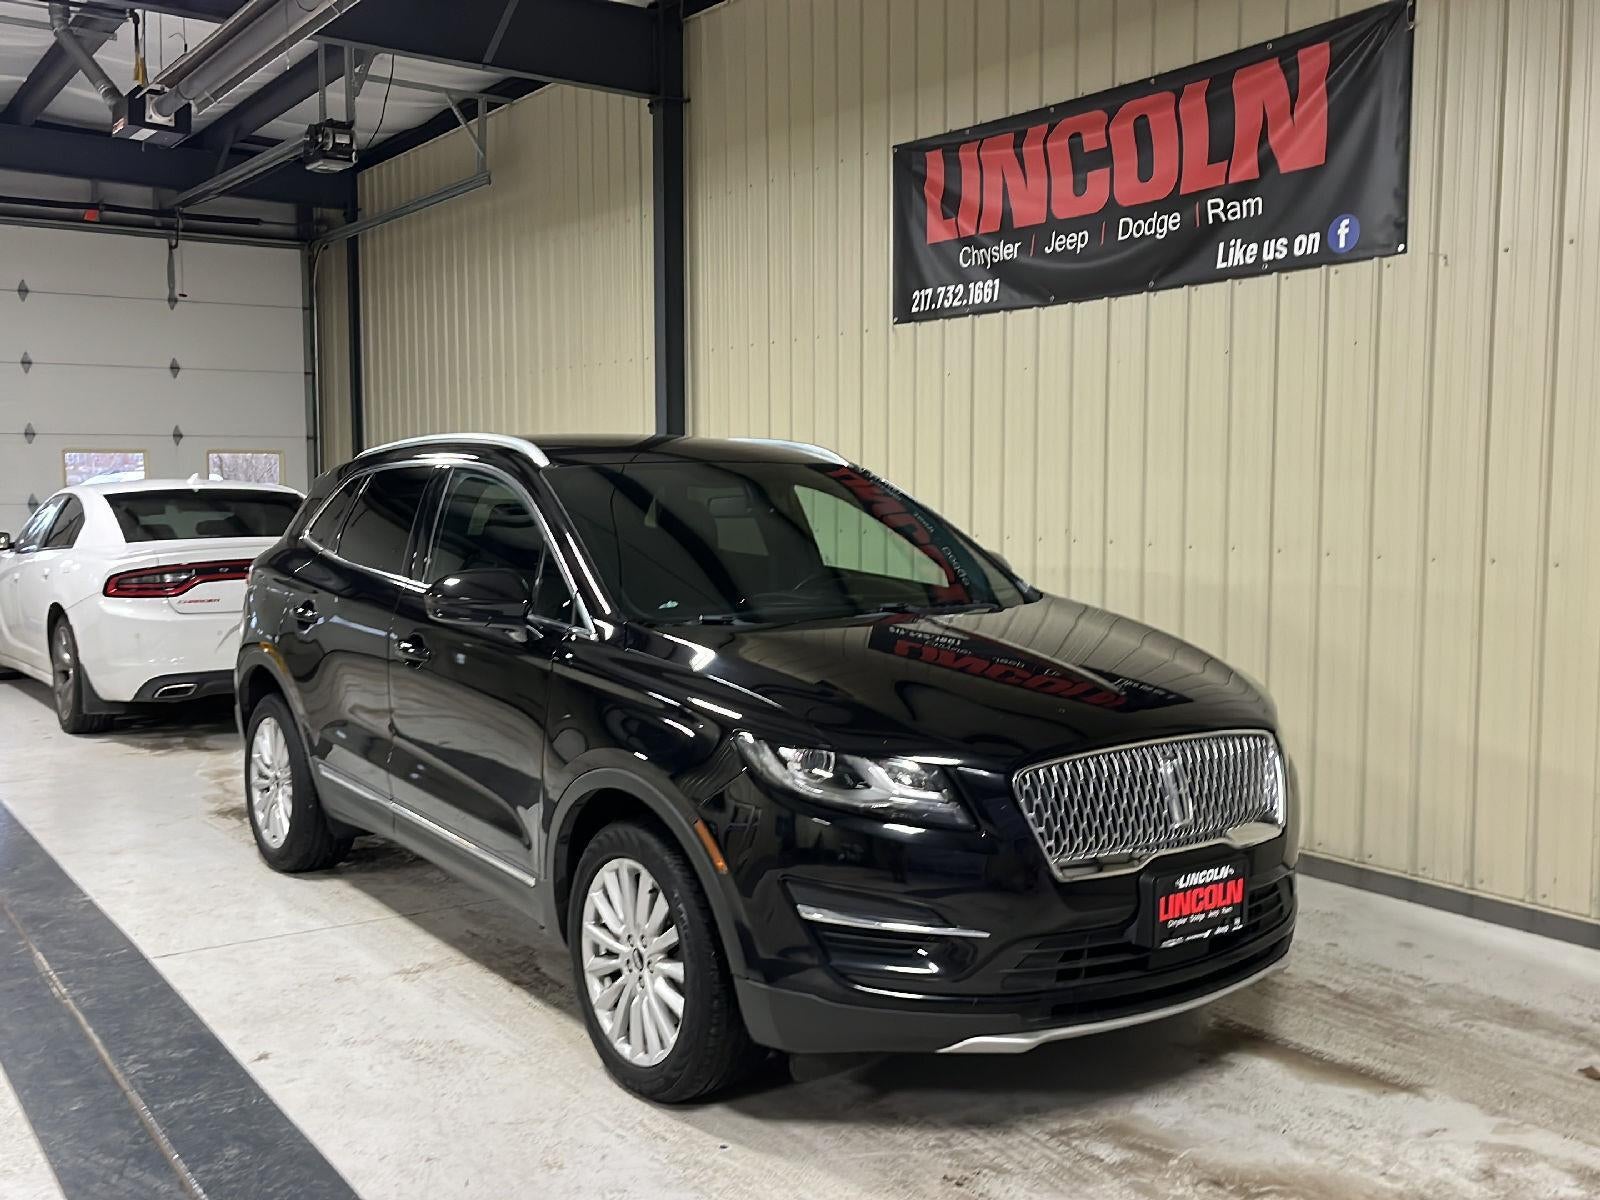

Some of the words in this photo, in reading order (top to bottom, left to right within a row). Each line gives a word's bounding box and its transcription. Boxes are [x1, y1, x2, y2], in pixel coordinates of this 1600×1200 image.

[923, 41, 1330, 245] LINCOLN
[959, 239, 1023, 269] Chrysler
[1044, 229, 1089, 255] Jeep
[1117, 211, 1181, 240] Dodge
[1207, 196, 1263, 225] Ram
[1216, 238, 1257, 269] Like
[1262, 237, 1288, 262] us
[1293, 231, 1321, 255] on
[911, 278, 1000, 313] 217.732.1661
[1177, 864, 1231, 889] LINCOLN
[1158, 877, 1244, 923] LINCOLN
